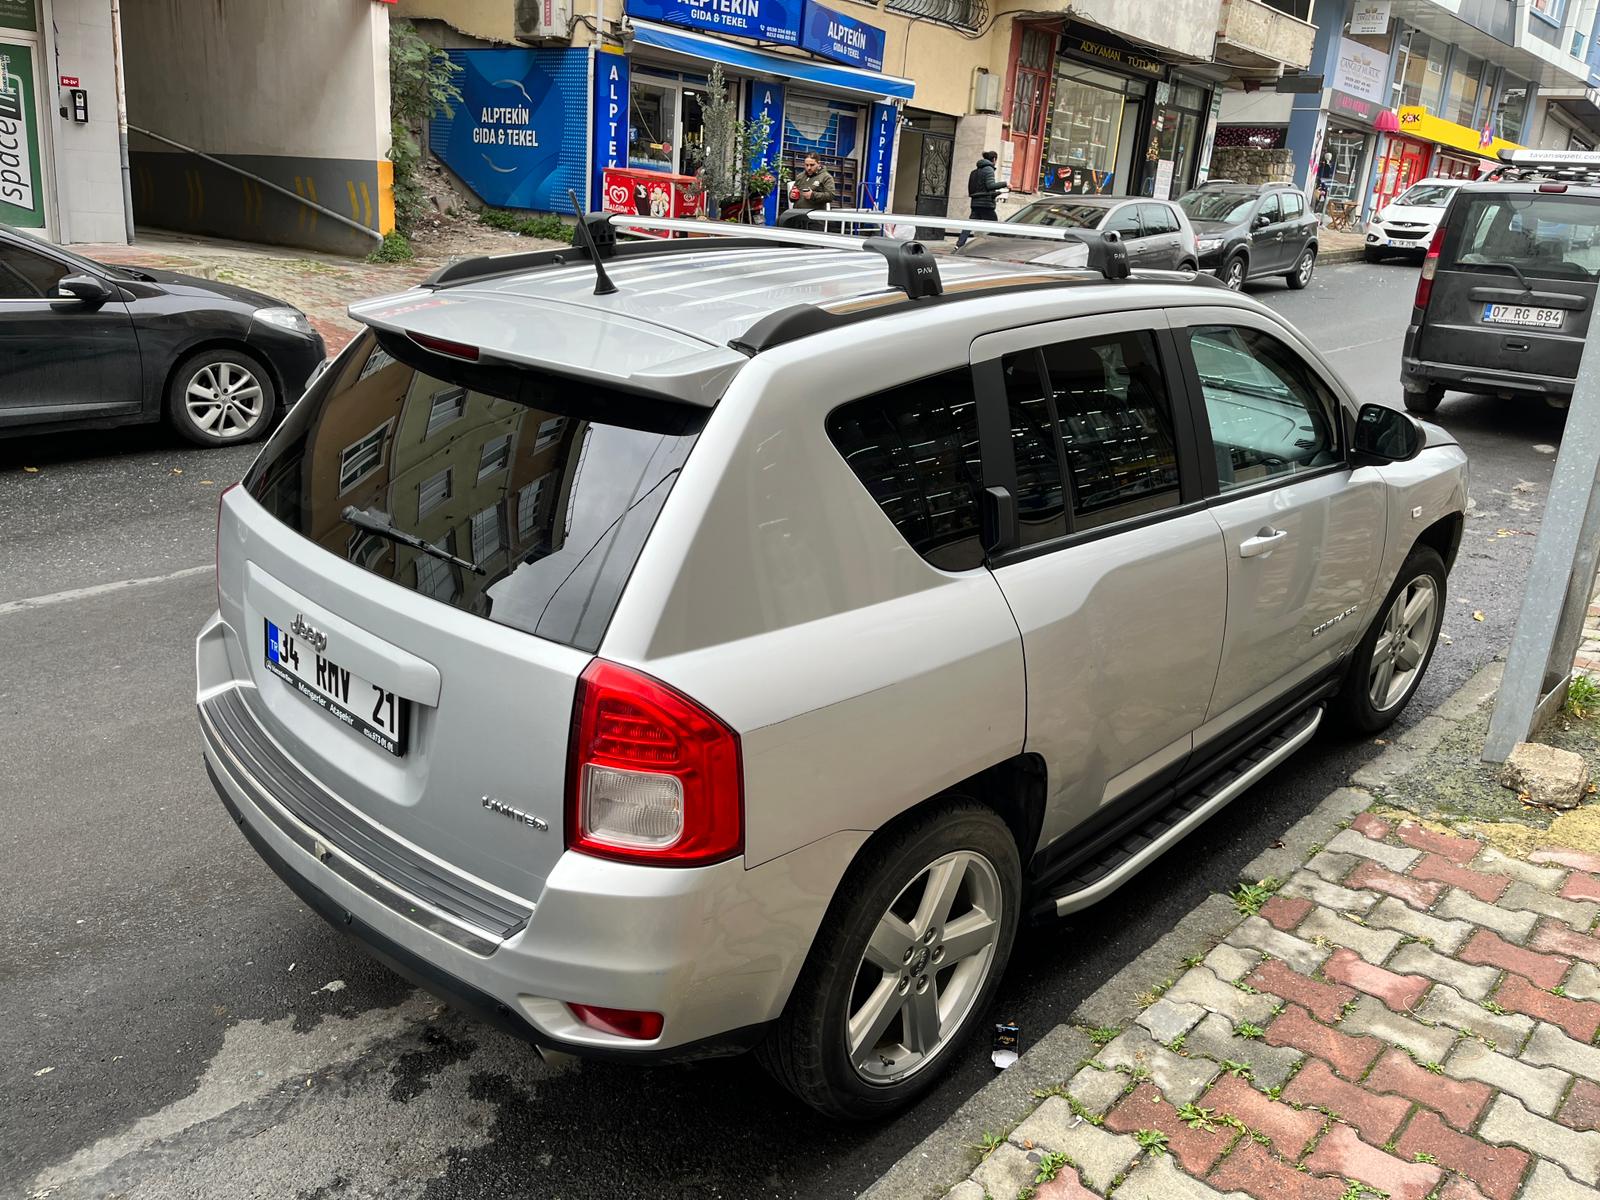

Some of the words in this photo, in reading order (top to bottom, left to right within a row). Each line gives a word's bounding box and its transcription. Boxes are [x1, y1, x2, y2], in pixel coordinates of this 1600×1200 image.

[691, 9, 712, 21] GIDA
[713, 13, 720, 23] &
[721, 15, 748, 28] TEKEL
[827, 21, 867, 49] ALPTEKİN
[847, 48, 860, 59] TEKEL
[481, 104, 529, 125] ALPTEKİN
[608, 65, 619, 169] ALPTEK
[473, 127, 496, 144] GIDA
[498, 128, 505, 145] &
[506, 129, 539, 147] TEKEL
[0, 121, 29, 201] space
[917, 267, 933, 275] PAW
[1493, 306, 1508, 318] 07
[1514, 308, 1530, 320] RG
[1536, 310, 1560, 322] 684
[290, 613, 328, 653] Jeep
[270, 639, 279, 654] TR
[279, 628, 300, 672] 34
[316, 653, 350, 705] RMV
[372, 684, 395, 735] 21
[298, 682, 327, 708] Mengerler
[329, 703, 354, 726] Ataşehir
[482, 795, 549, 832] LIMITED
